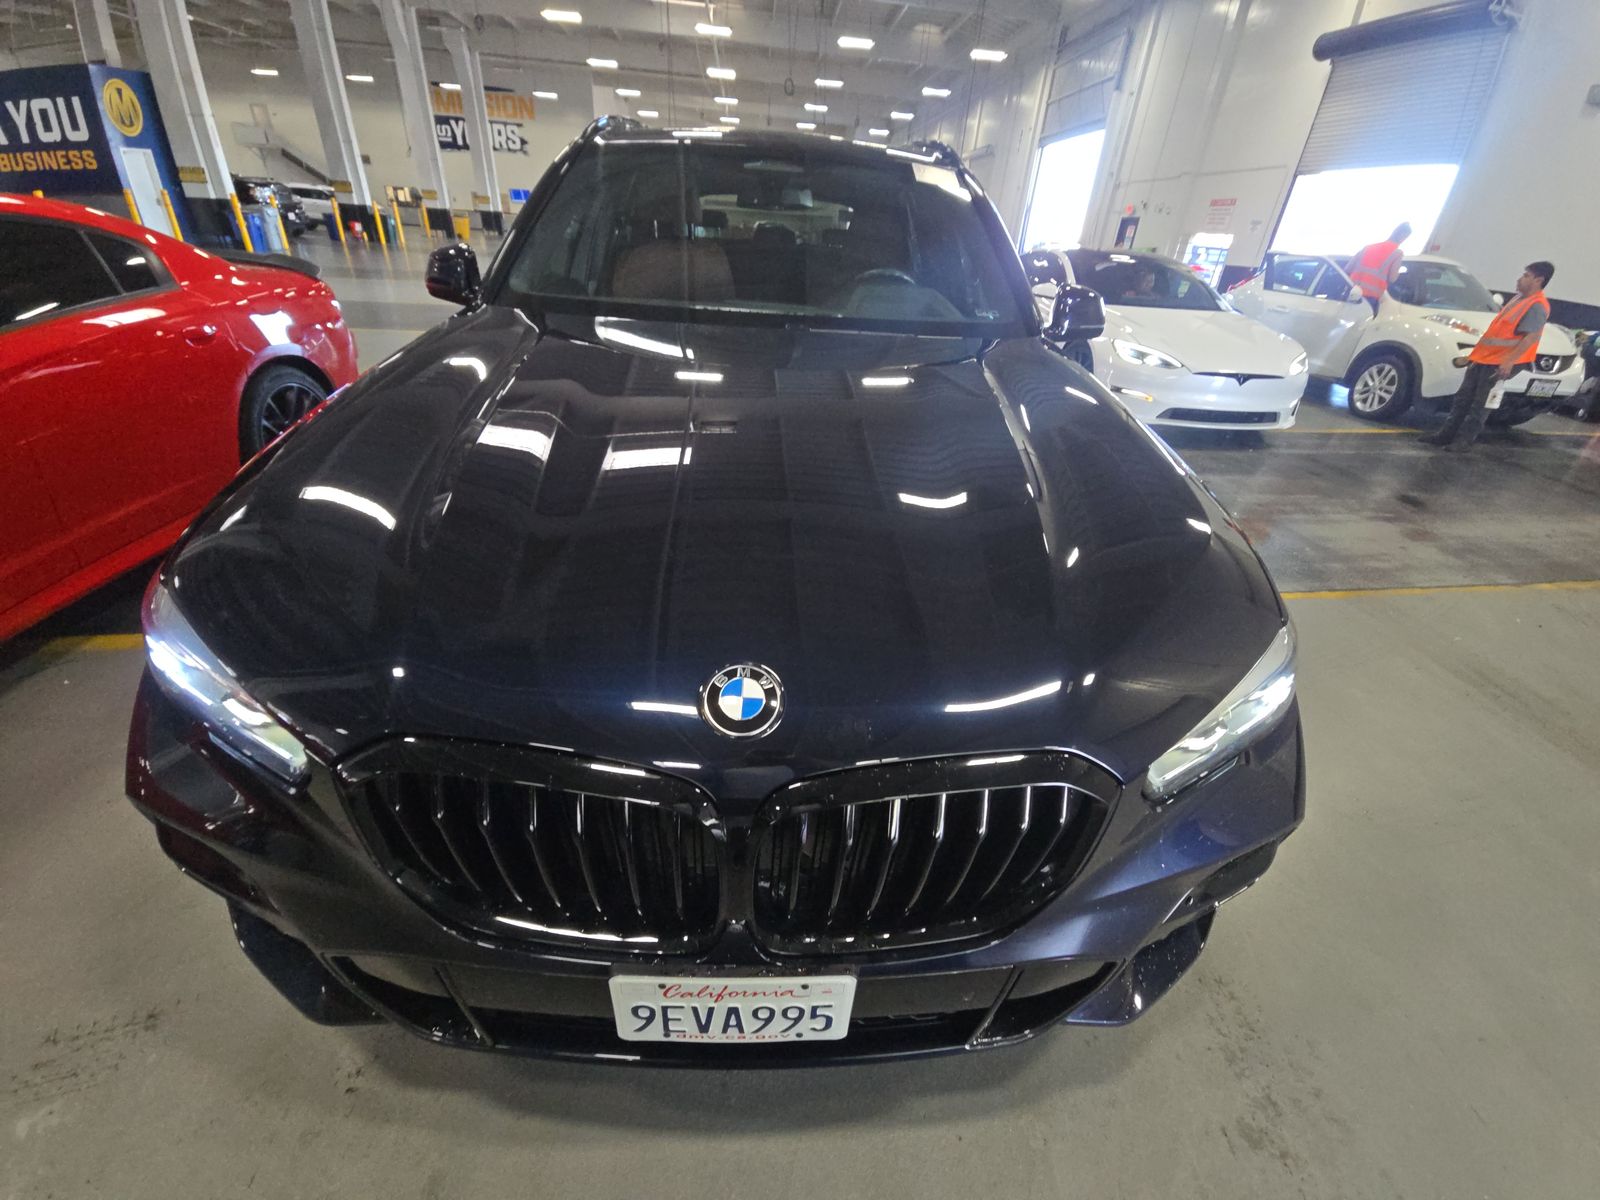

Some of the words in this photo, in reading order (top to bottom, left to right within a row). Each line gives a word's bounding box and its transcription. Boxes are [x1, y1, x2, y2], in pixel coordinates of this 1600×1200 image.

[4, 95, 90, 144] YOU
[434, 89, 535, 120] MISION
[449, 119, 522, 150] YRS
[0, 149, 98, 172] BUSINESS
[714, 666, 775, 690] BMW
[663, 983, 808, 1003] California
[630, 1004, 834, 1035] 9EVA995
